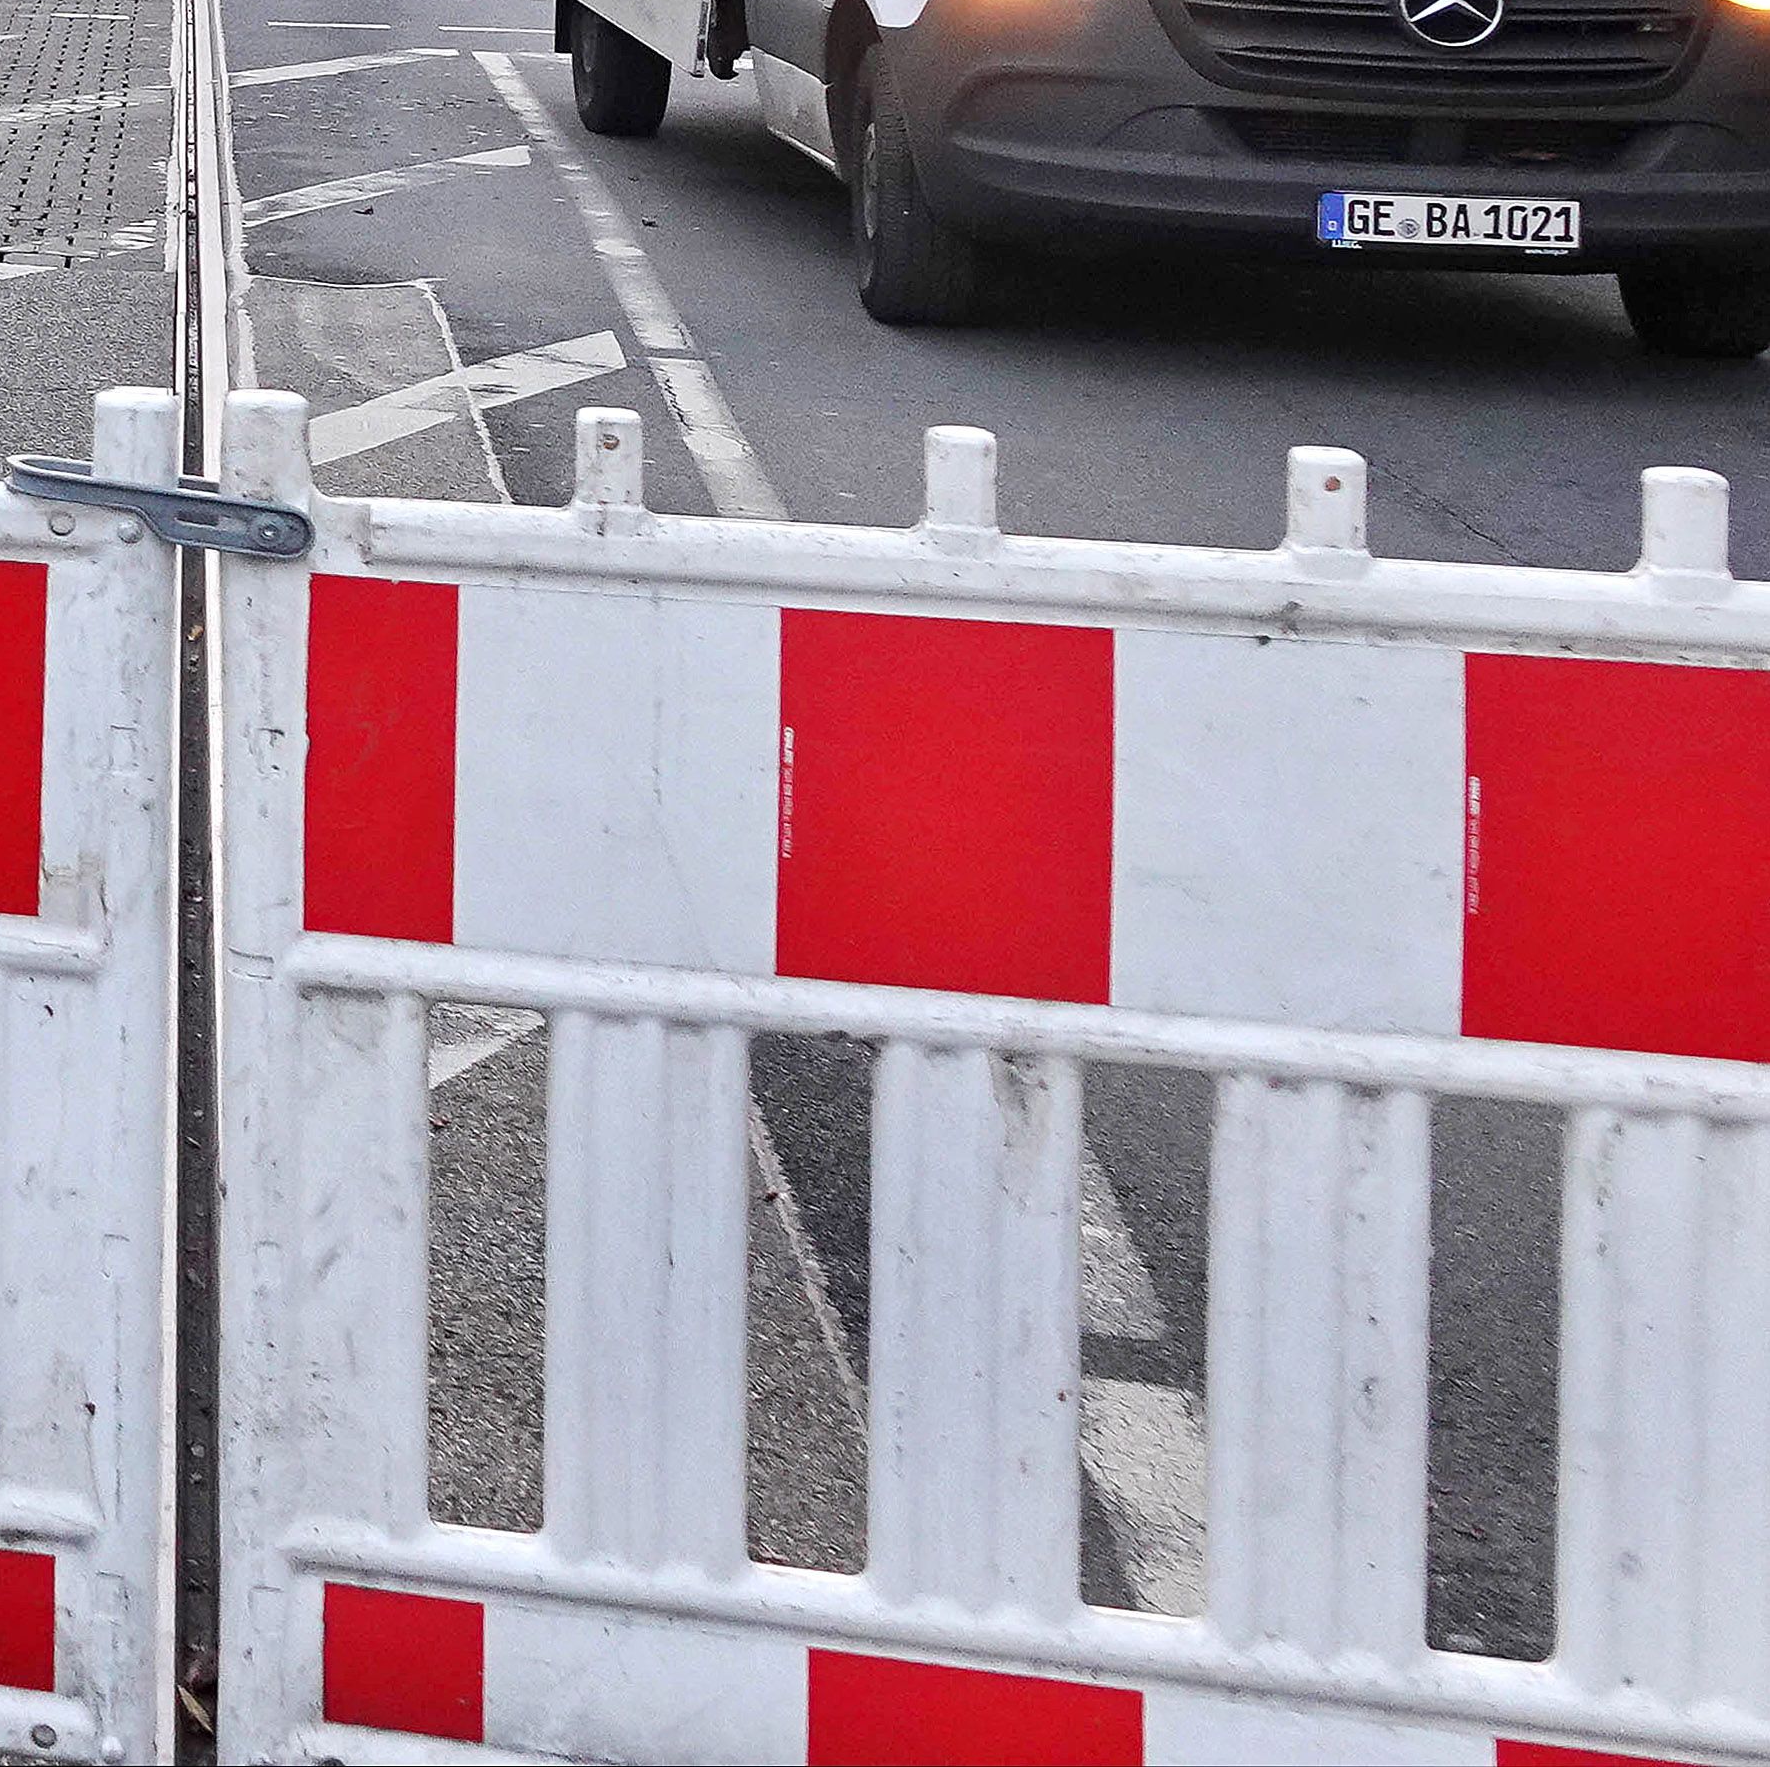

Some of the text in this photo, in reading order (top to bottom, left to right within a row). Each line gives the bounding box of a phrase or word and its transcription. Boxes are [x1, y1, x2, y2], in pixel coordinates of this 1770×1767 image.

[1347, 199, 1395, 236] GE
[1426, 202, 1471, 239] BA
[1483, 204, 1575, 243] 1021
